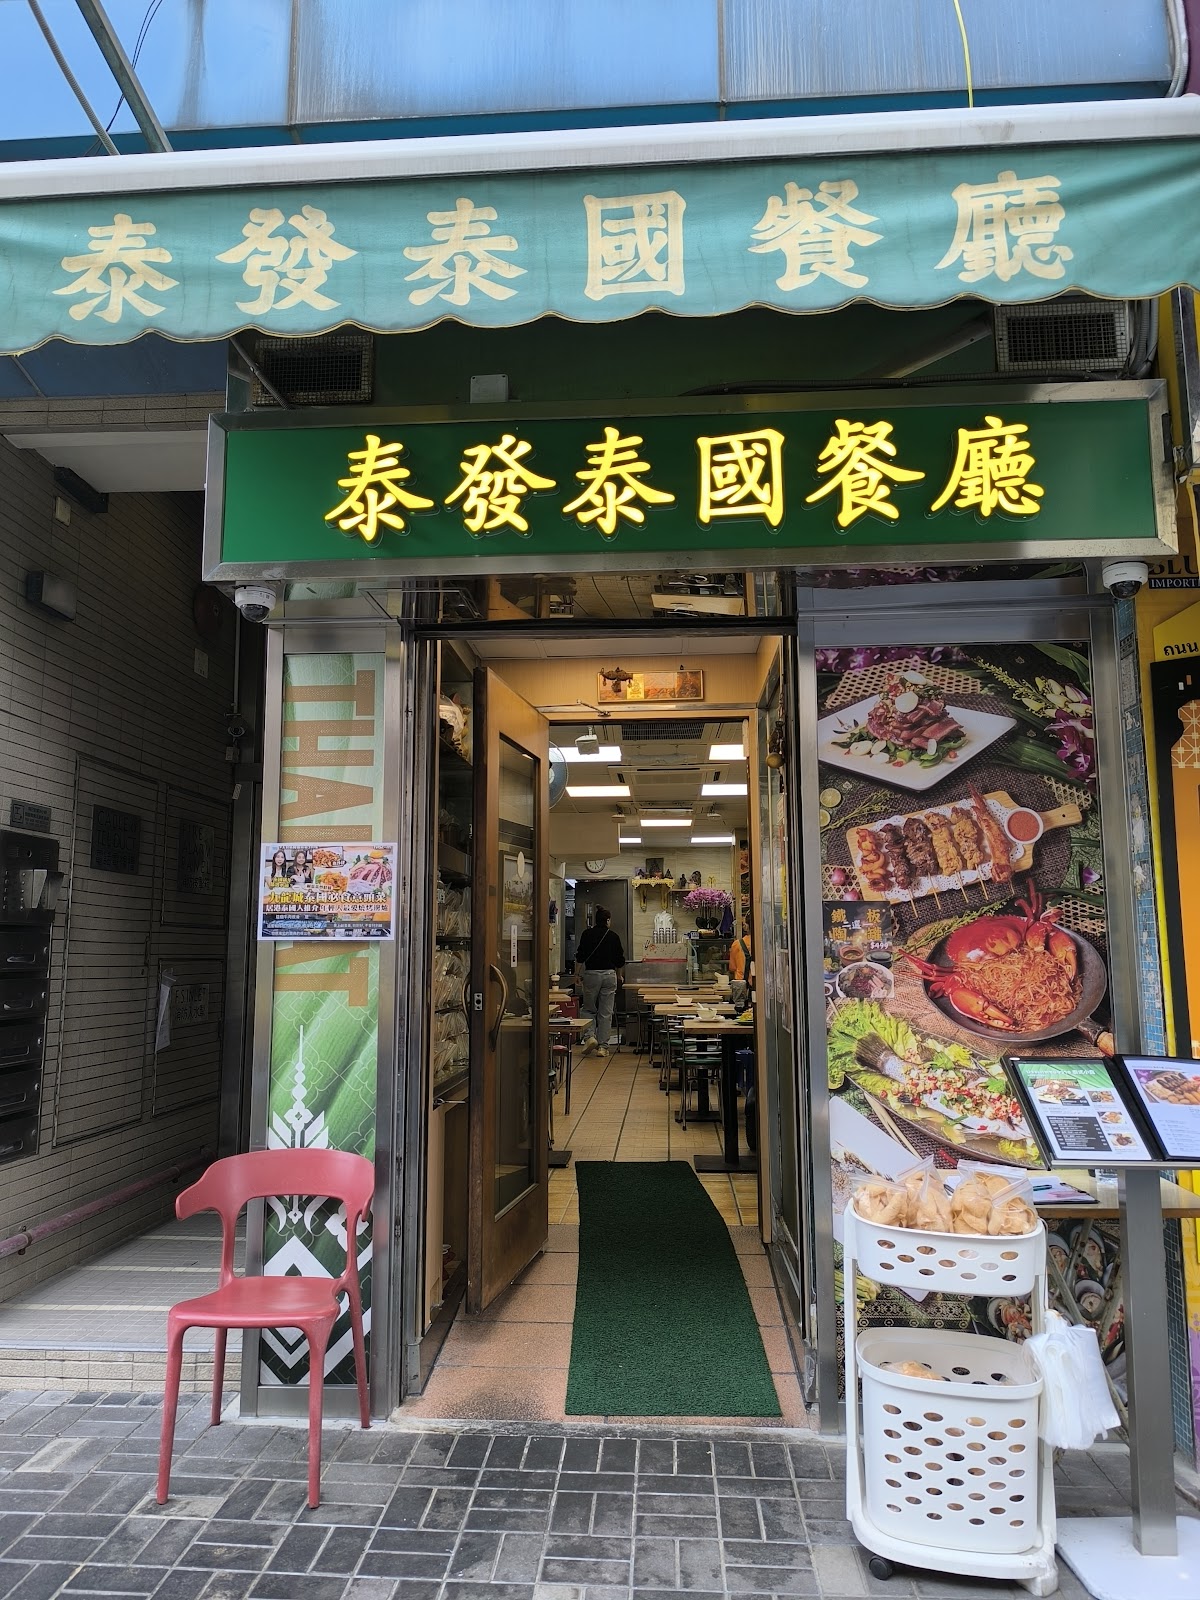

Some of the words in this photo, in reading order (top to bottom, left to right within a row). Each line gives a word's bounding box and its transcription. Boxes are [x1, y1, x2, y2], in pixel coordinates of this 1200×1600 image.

[53, 170, 1074, 323] 泰發泰國餐廳
[325, 416, 1045, 541] 泰發泰國餐廳
